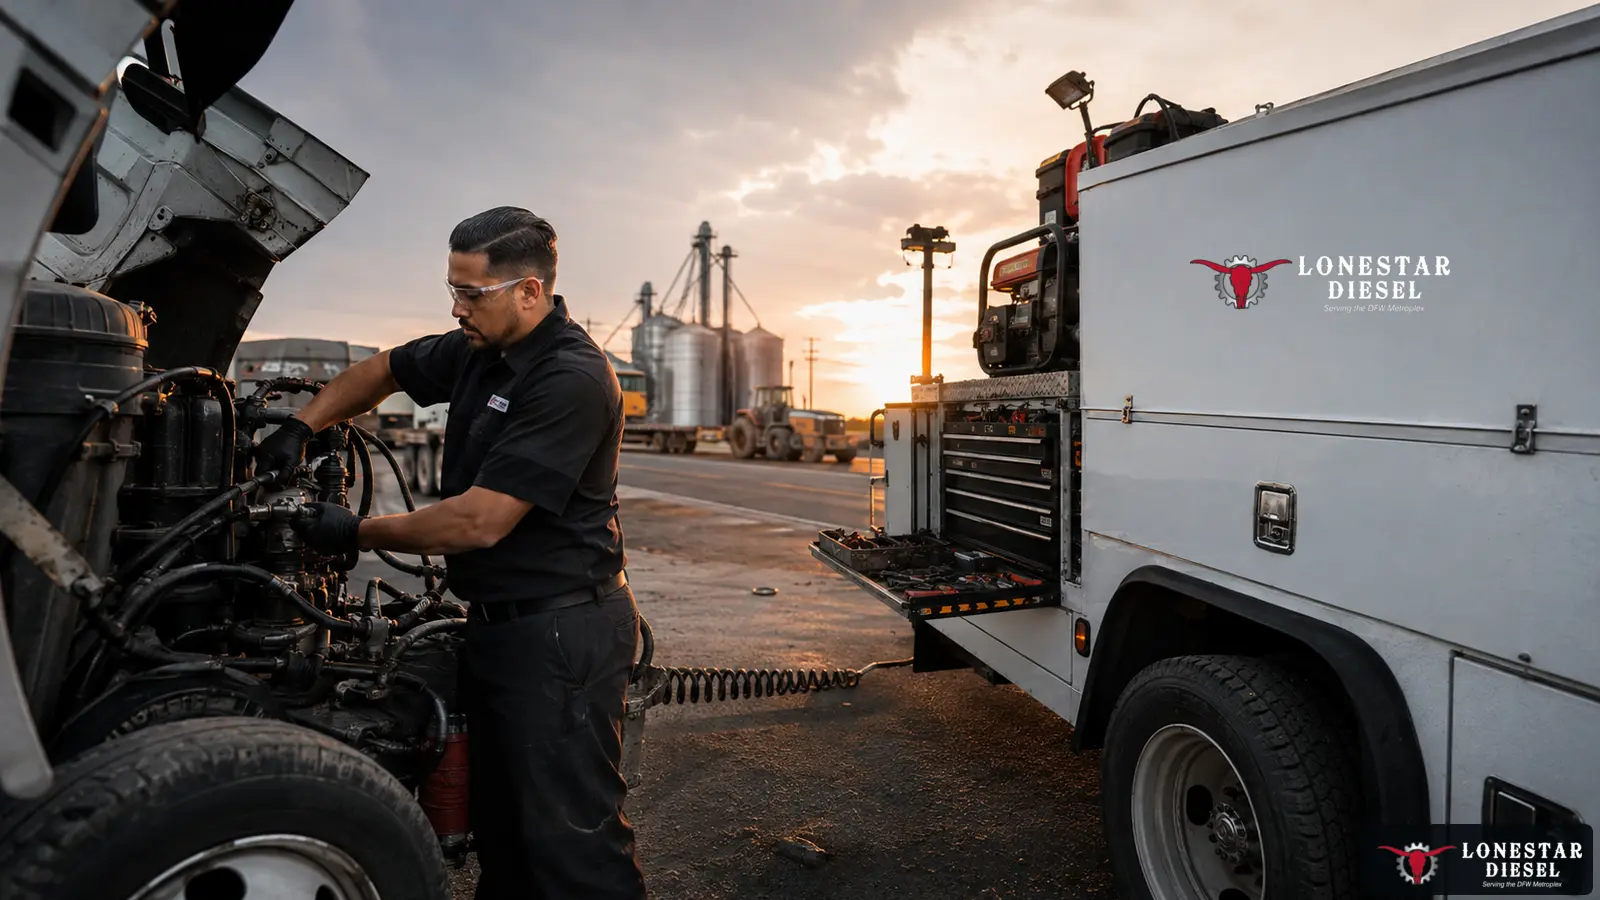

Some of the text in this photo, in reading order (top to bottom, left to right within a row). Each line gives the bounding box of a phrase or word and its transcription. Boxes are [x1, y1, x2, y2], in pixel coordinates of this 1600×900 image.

[1298, 255, 1451, 277] LONESTAR
[1328, 280, 1422, 300] DIESEL
[1323, 304, 1425, 314] Serving the DFW Metroplex
